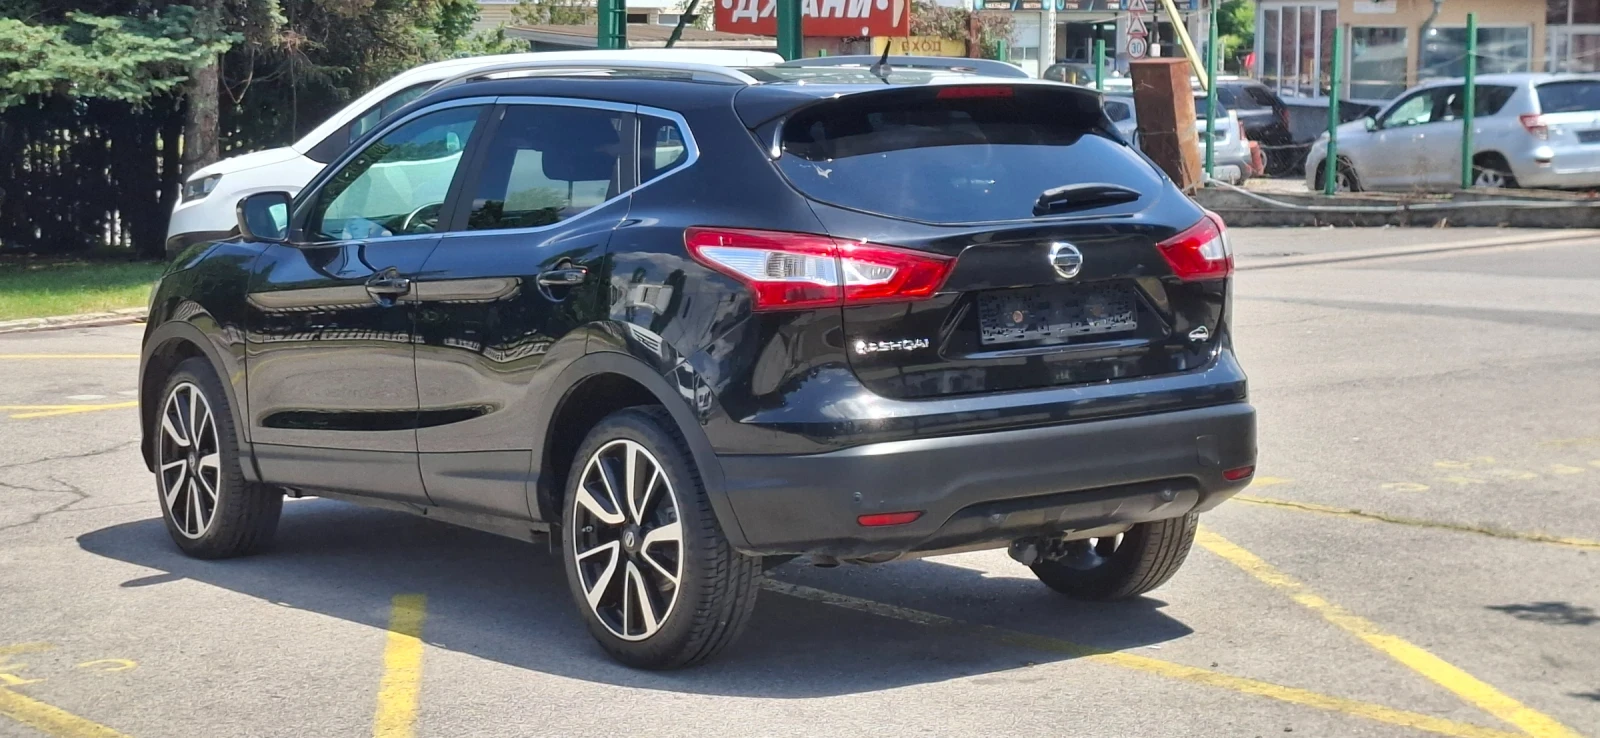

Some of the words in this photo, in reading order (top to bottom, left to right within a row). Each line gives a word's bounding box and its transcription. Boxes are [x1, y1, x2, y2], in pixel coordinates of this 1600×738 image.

[901, 40, 942, 52] ВХОД
[1131, 42, 1142, 54] 30
[855, 338, 930, 355] QASHQAI
